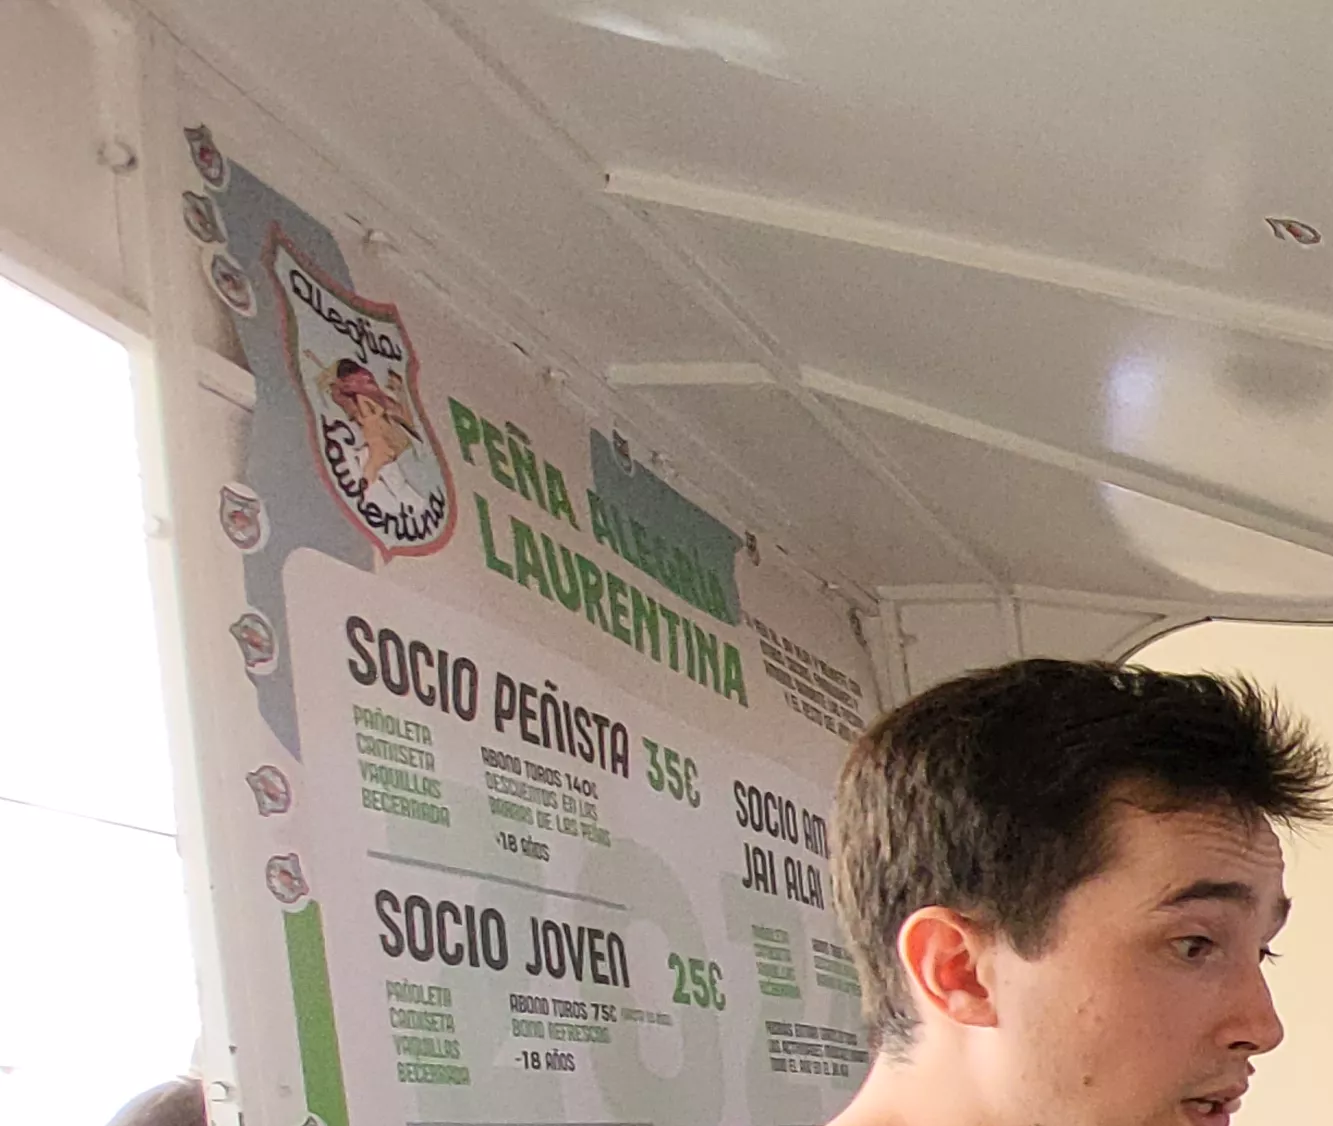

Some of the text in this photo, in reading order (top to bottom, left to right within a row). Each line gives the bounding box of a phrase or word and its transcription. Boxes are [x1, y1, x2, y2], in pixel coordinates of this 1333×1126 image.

[448, 396, 581, 531] PEÑA
[474, 491, 749, 708] LAURENTINA
[346, 615, 478, 721] SOCIO
[495, 671, 630, 779] PEÑISTA
[642, 736, 701, 809] 35€
[353, 703, 432, 746] PAÑOLETA
[356, 732, 435, 772] CAMISETA
[481, 746, 521, 775] ABONO
[524, 760, 562, 788] TOROS
[358, 759, 441, 799] VAQUILLAS
[734, 780, 799, 844] SOCIO
[742, 842, 824, 910] JAI ALAI
[374, 889, 508, 971] SOCIO
[526, 916, 630, 988] JOVEN
[668, 952, 726, 1011] 25€
[509, 994, 549, 1016] ABONO
[551, 998, 588, 1021] TOROS
[591, 1003, 617, 1022] 75€
[515, 1048, 576, 1072] -18 AÑOS
